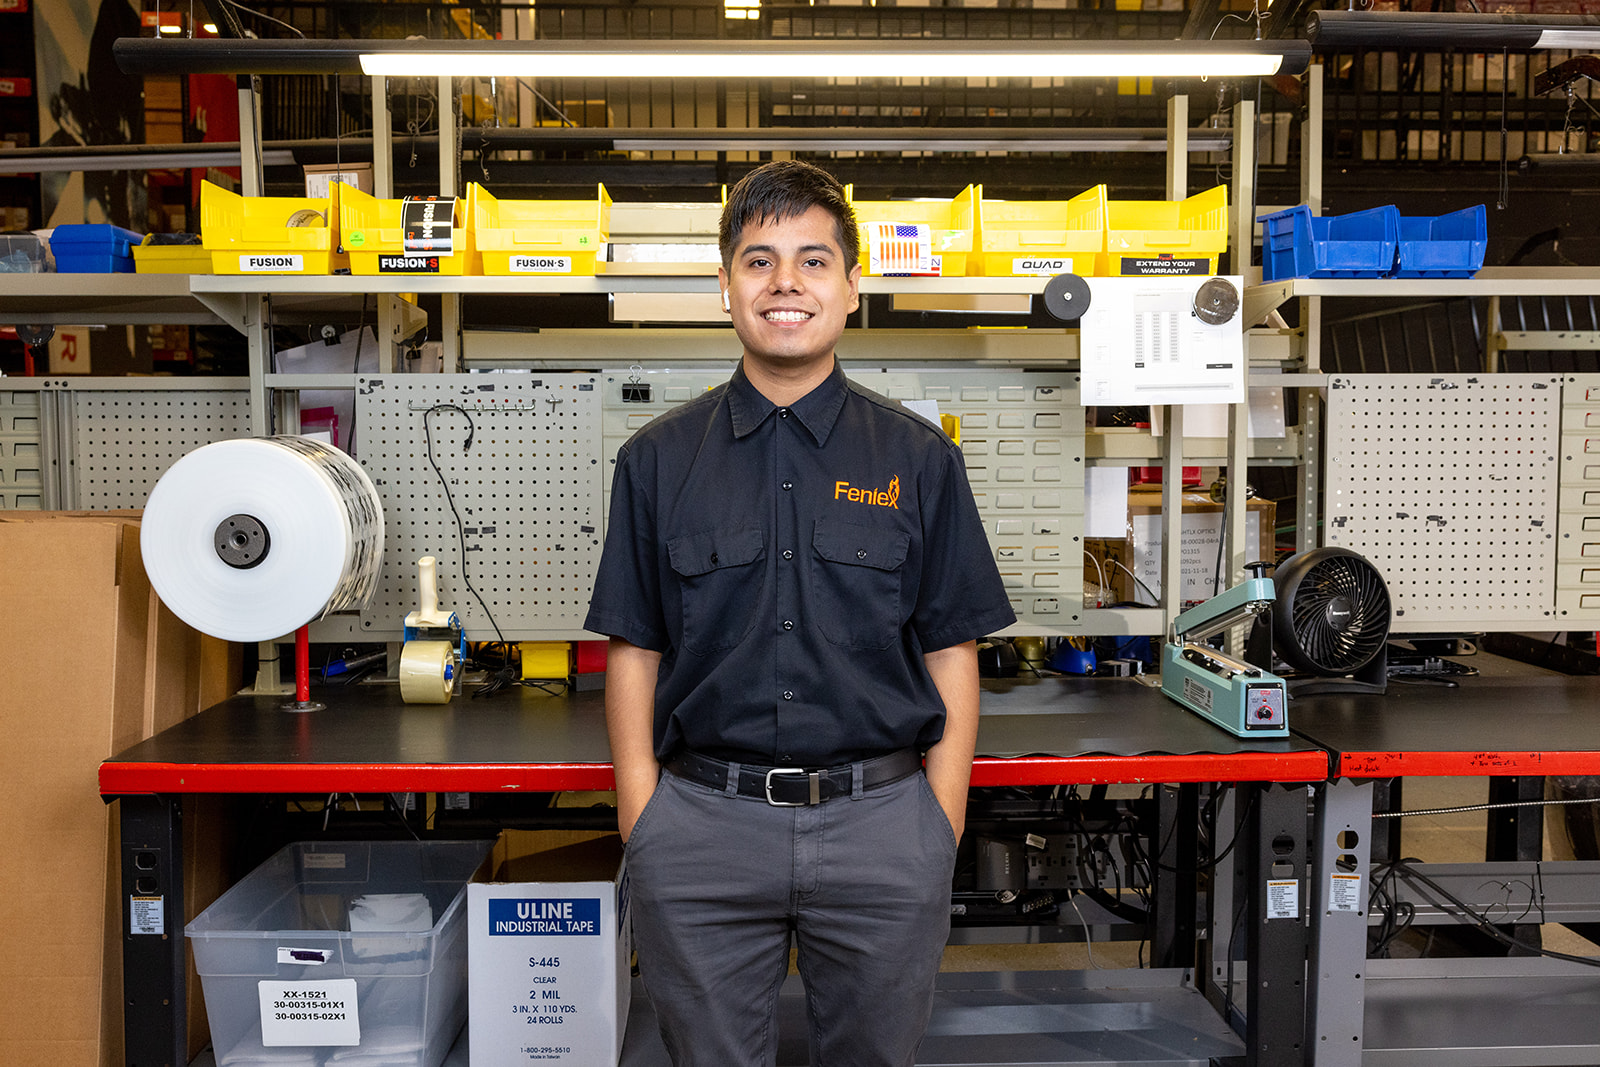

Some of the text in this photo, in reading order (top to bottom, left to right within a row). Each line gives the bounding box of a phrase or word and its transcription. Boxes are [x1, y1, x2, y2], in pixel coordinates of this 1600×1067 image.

[249, 258, 293, 267] FUSION
[834, 474, 900, 510] Feniex
[517, 902, 573, 919] ULINE
[496, 921, 594, 932] INDUSTRIAL TAPE
[529, 957, 560, 967] S-445
[530, 990, 560, 999] 2 MIL
[512, 1005, 577, 1013] 3 IN. X 110 YDS.
[527, 1016, 563, 1024] 24 ROLLS
